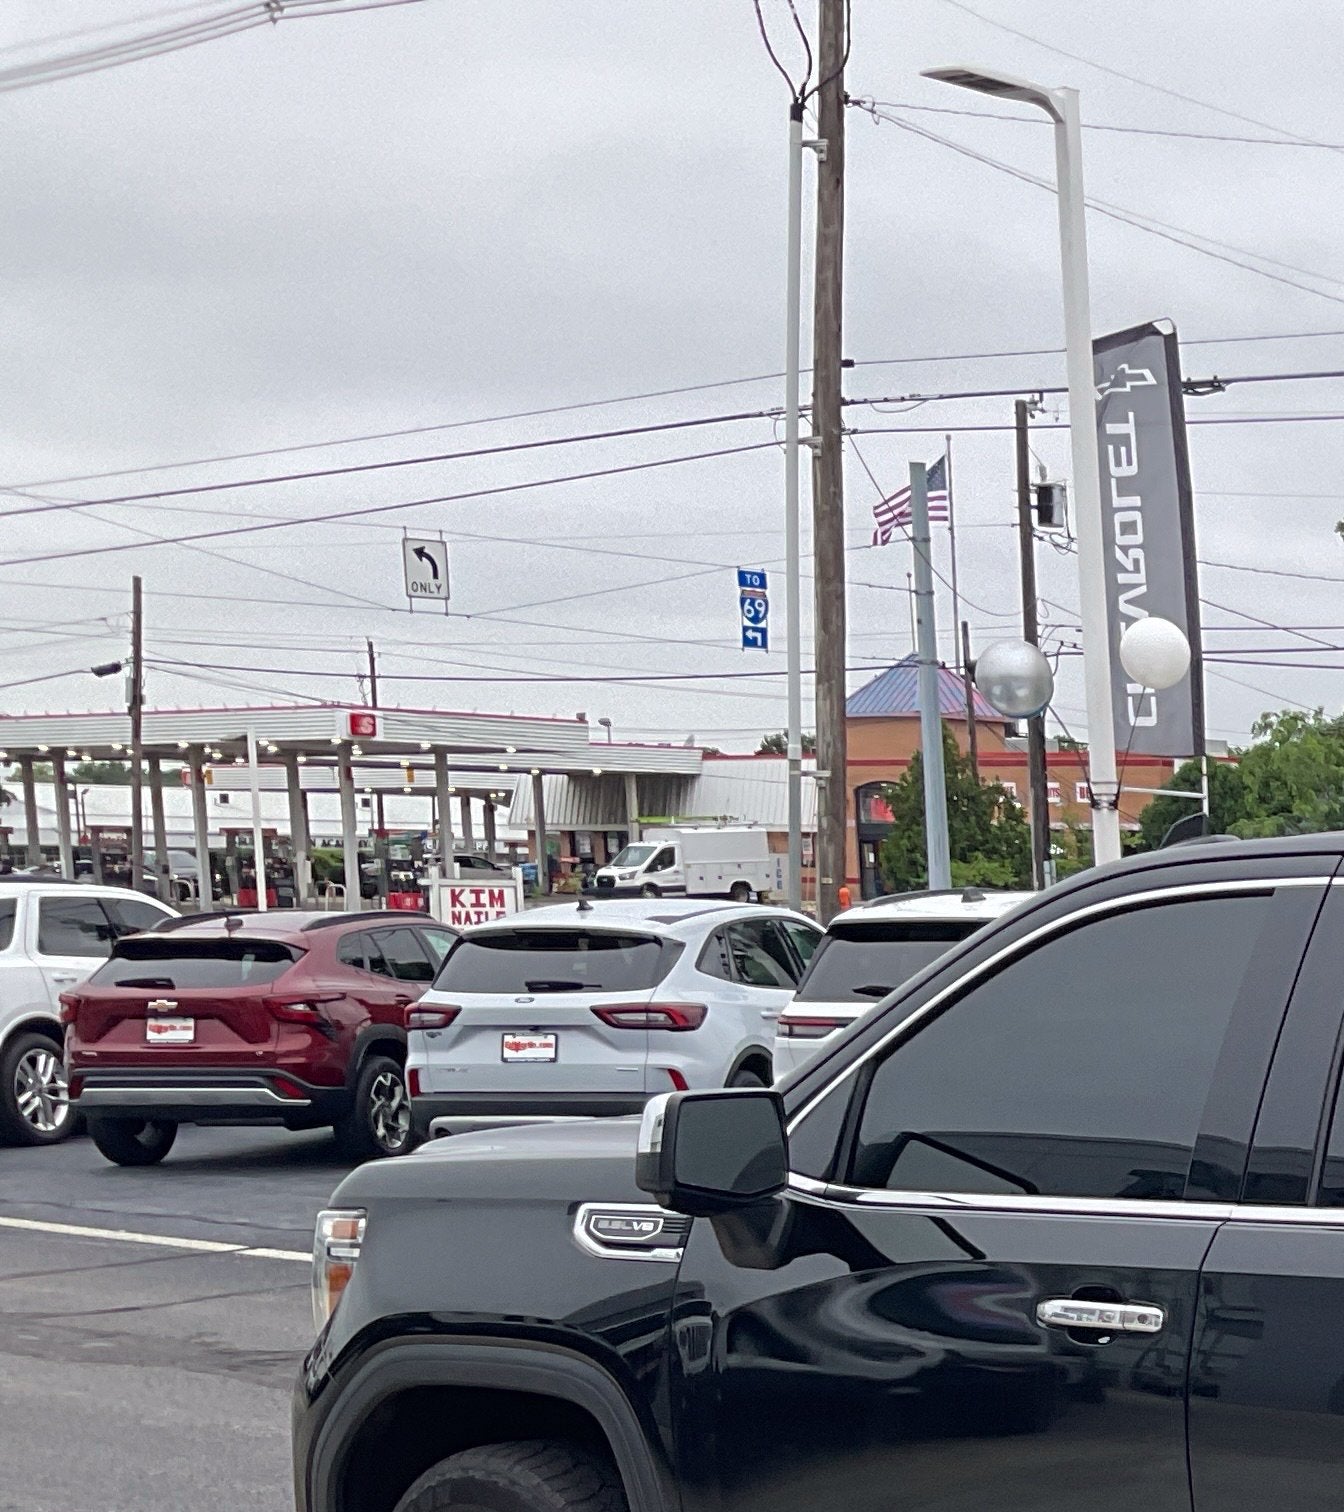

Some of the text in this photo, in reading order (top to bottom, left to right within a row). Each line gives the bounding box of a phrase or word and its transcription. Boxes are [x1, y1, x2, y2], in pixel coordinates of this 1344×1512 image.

[411, 581, 442, 594] ONLY
[744, 573, 760, 586] TO
[743, 598, 766, 618] 69
[450, 888, 506, 908] KIM
